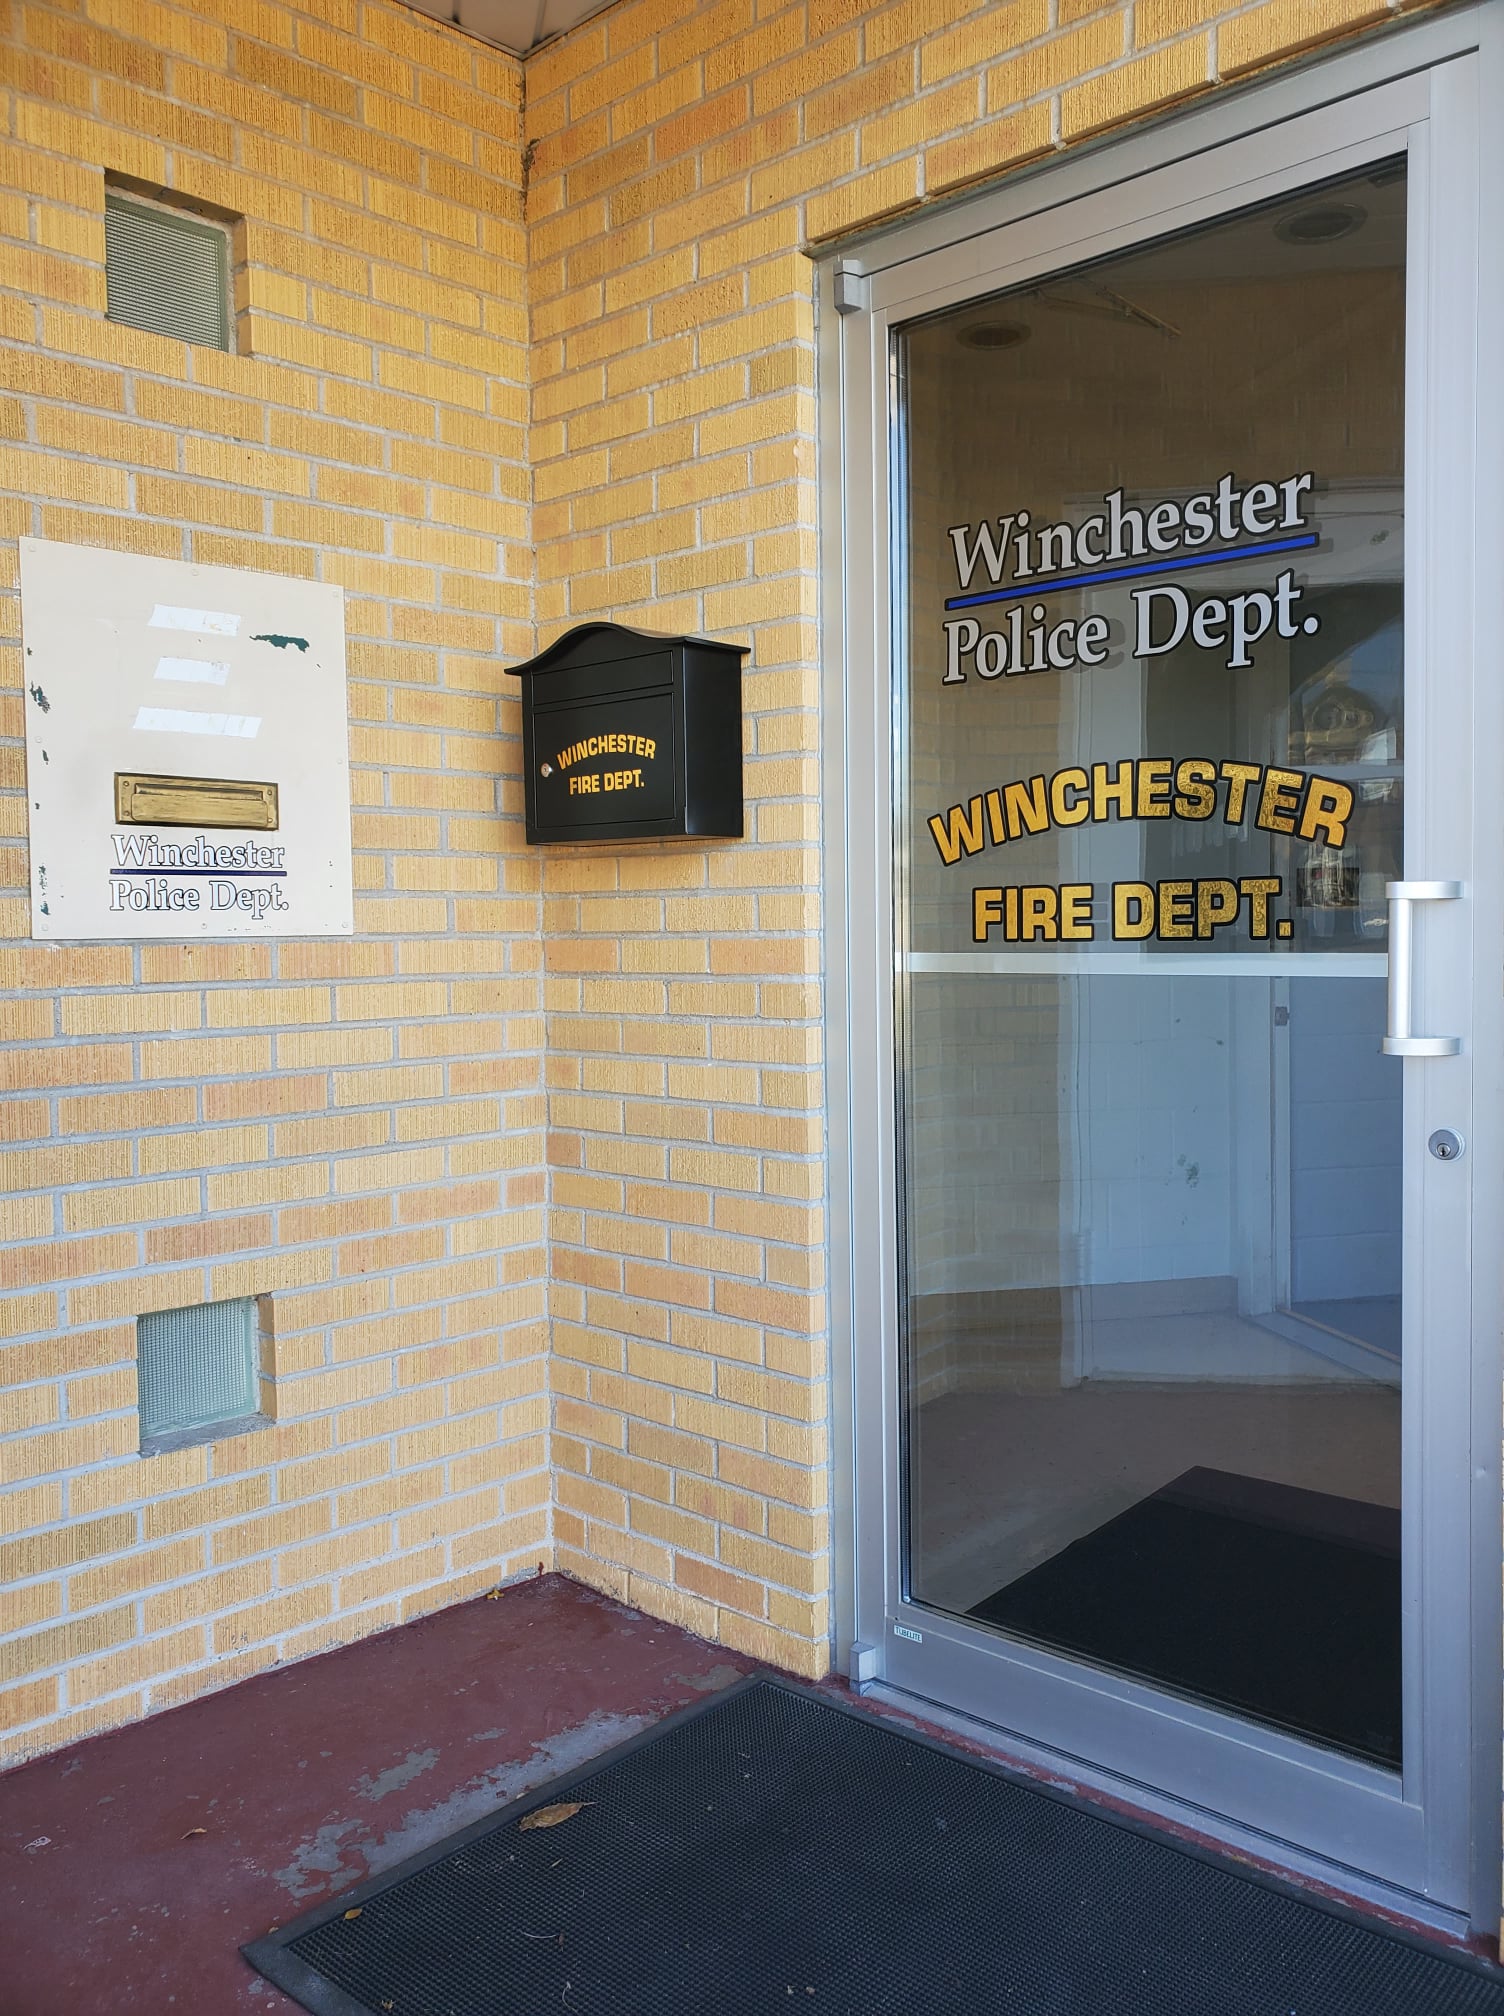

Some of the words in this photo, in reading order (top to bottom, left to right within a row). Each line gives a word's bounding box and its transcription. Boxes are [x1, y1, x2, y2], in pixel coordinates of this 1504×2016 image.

[948, 471, 1313, 590] Winchester
[942, 601, 1110, 685] Police
[1130, 567, 1322, 670] Dept.
[557, 734, 656, 770] WINCHESTER
[569, 774, 600, 795] FIRE
[603, 768, 645, 792] DEPT.
[927, 757, 1355, 867] WINCHESTER
[110, 833, 285, 869] Winchester
[109, 878, 200, 912] Police
[208, 880, 290, 920] Dept.
[971, 882, 1095, 944] FIRE
[1109, 876, 1296, 942] DEPT.
